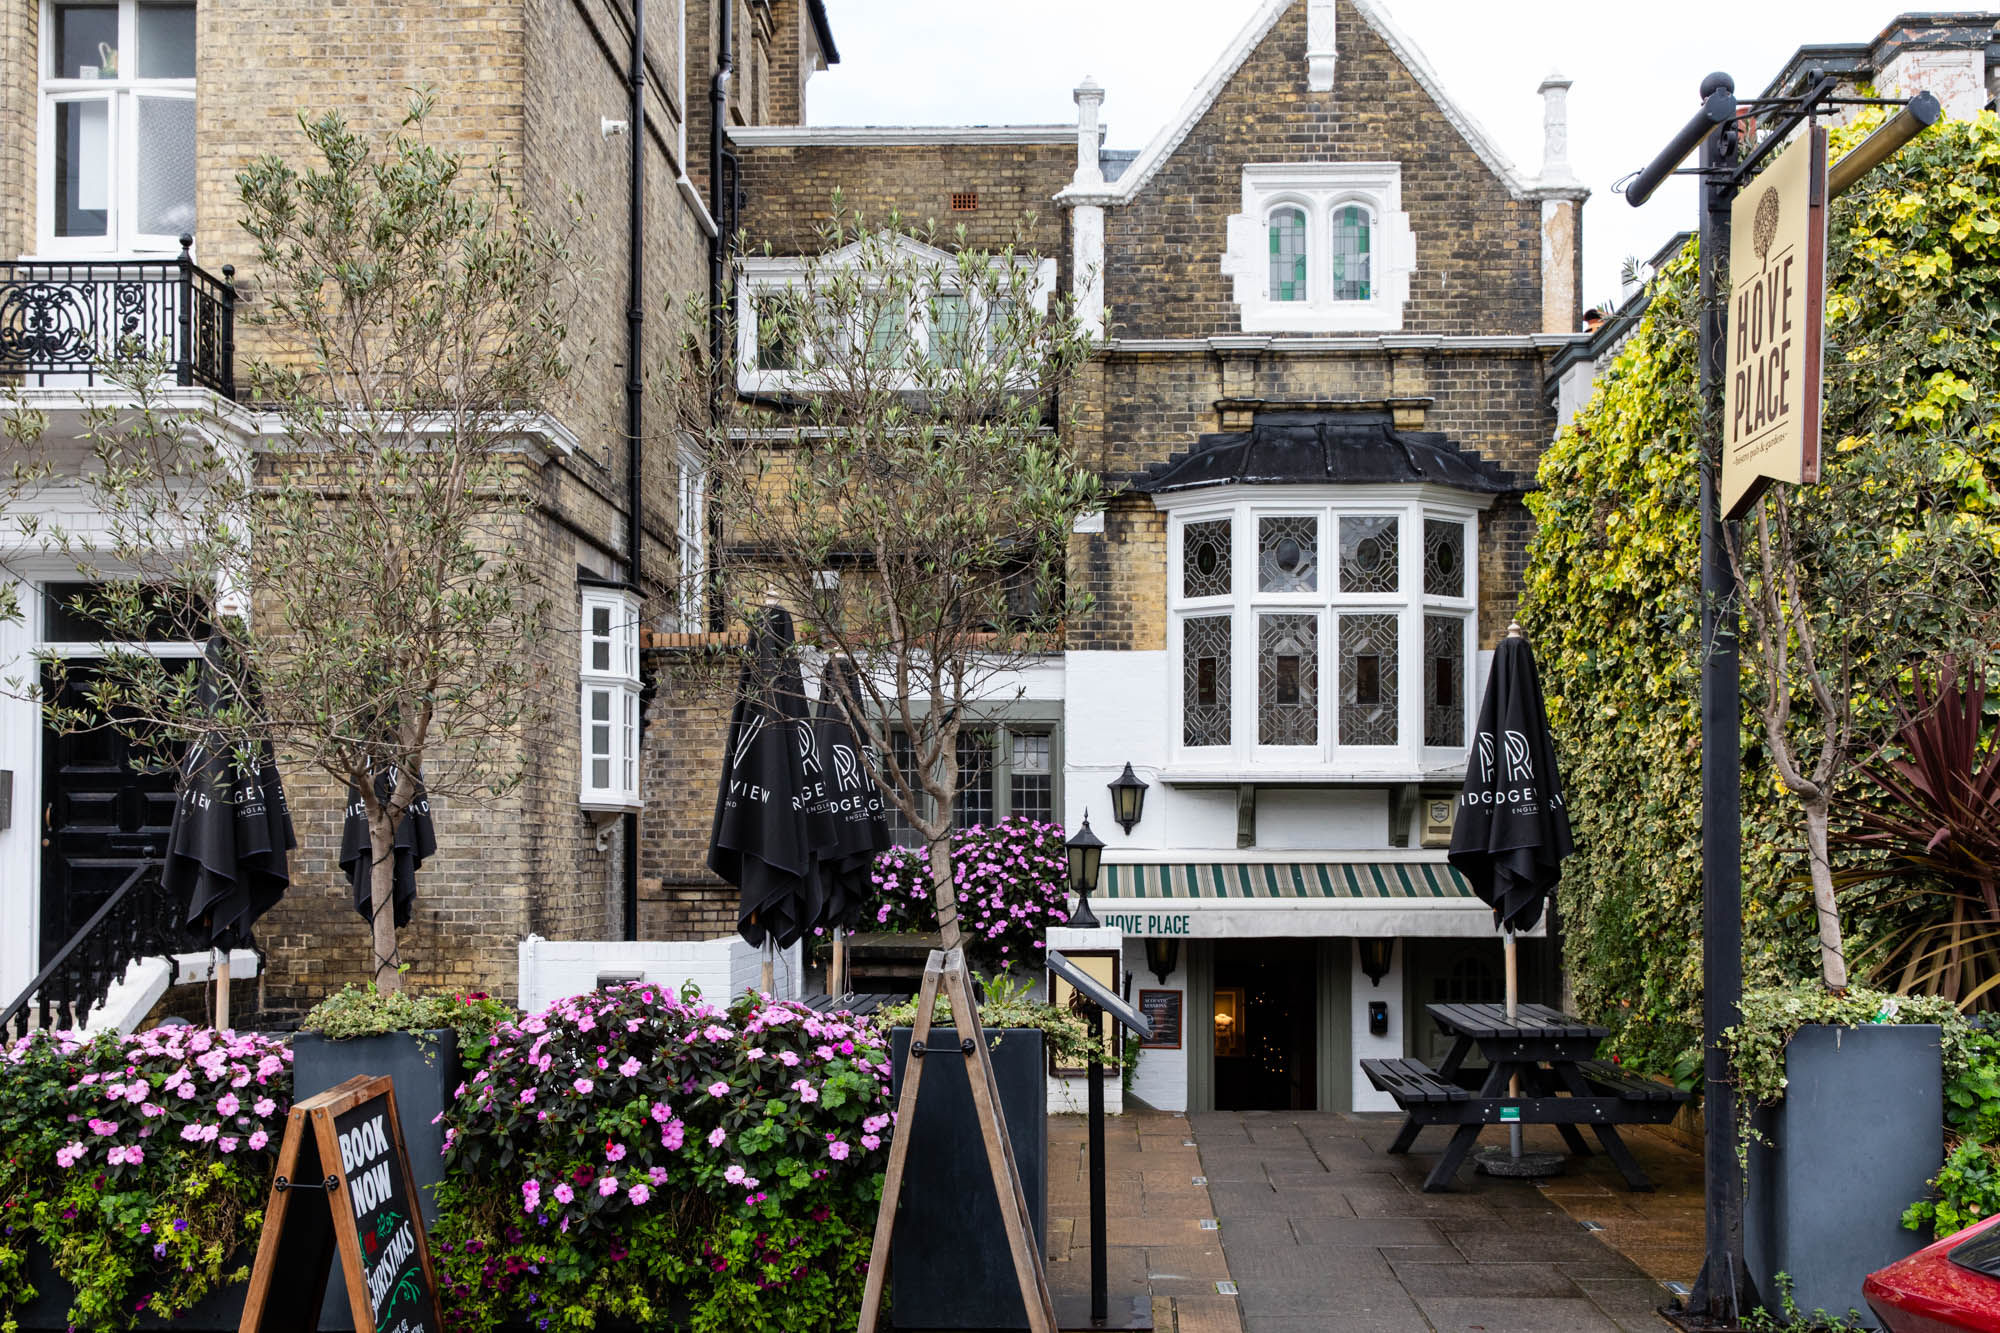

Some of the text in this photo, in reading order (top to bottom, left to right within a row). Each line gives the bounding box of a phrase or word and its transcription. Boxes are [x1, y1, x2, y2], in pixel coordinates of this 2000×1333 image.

[1736, 254, 1794, 366] HOVE
[1733, 337, 1791, 443] PLACE
[1105, 914, 1191, 935] HOVE PLACE
[338, 1114, 390, 1175] BOOK
[350, 1159, 393, 1219] NOW
